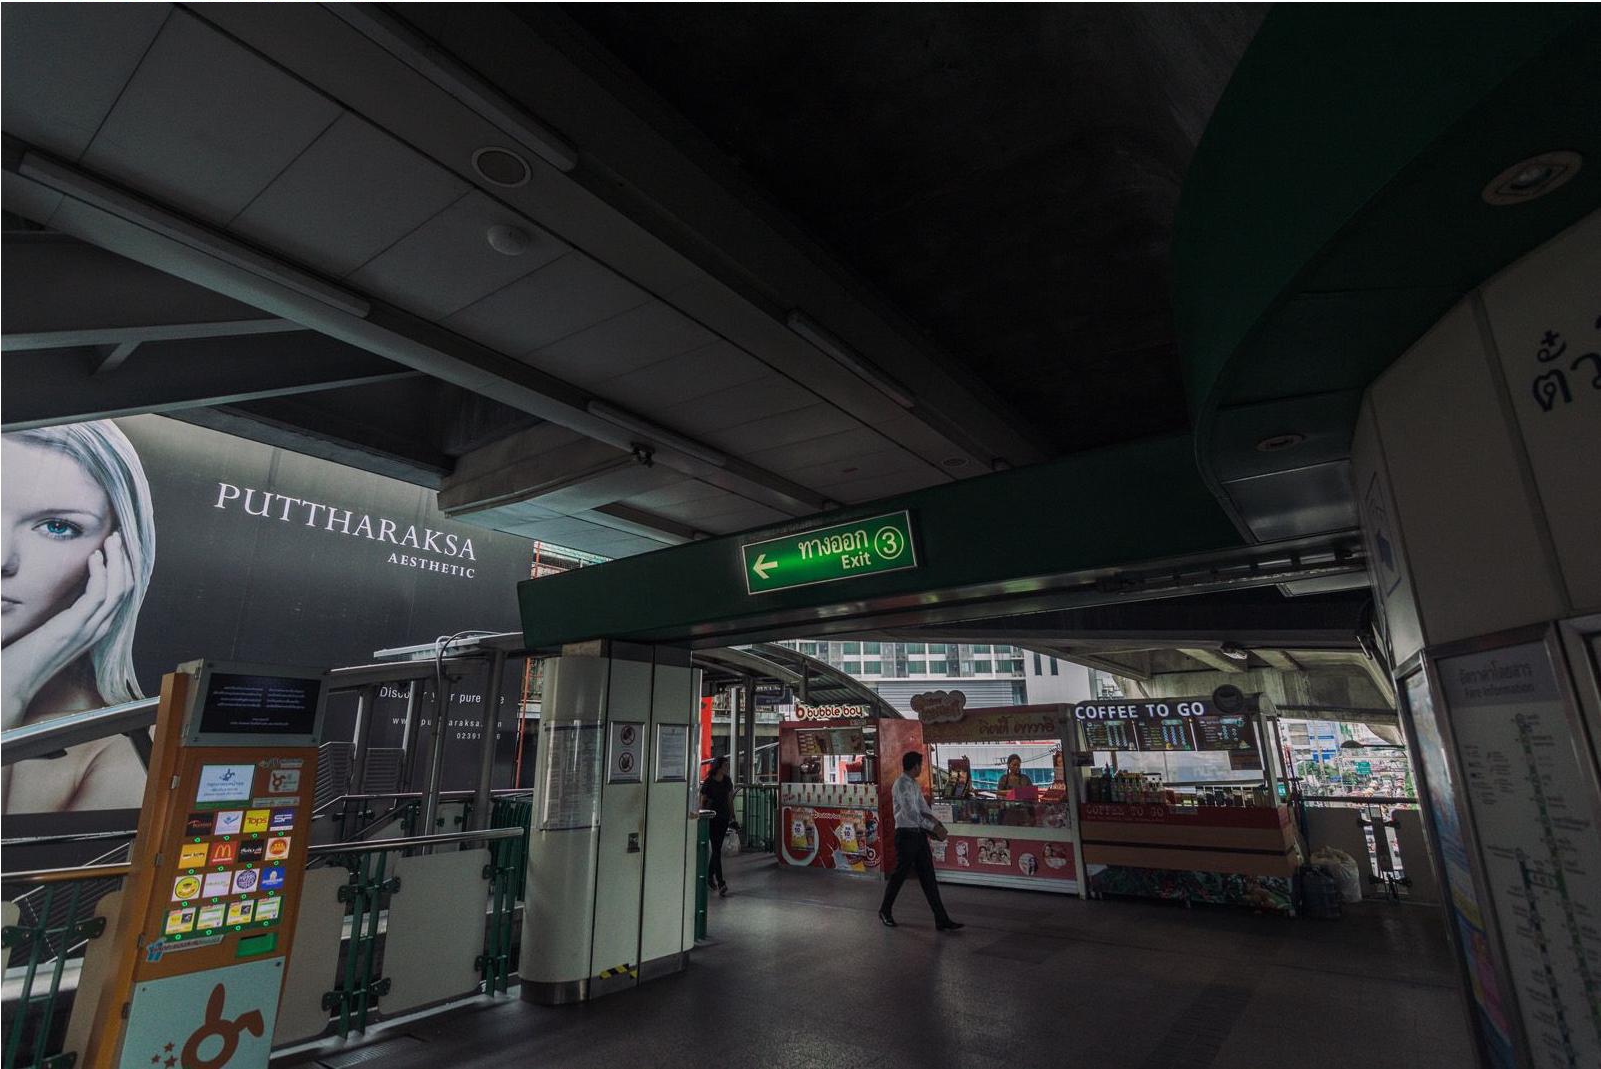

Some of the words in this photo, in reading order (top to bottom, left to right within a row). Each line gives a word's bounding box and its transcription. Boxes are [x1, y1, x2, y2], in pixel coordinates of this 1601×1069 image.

[213, 483, 477, 560] PUTTHARAKSA
[798, 530, 869, 560] ทางออก
[882, 532, 897, 554] 3
[388, 553, 475, 579] AESTHETIC
[841, 551, 872, 569] Exit
[459, 692, 482, 704] pure
[807, 706, 841, 717] bubble
[843, 706, 863, 716] boy
[1075, 705, 1139, 719] COFFEE
[1146, 704, 1169, 717] TO
[1177, 702, 1204, 716] GO
[247, 817, 267, 826] Tops
